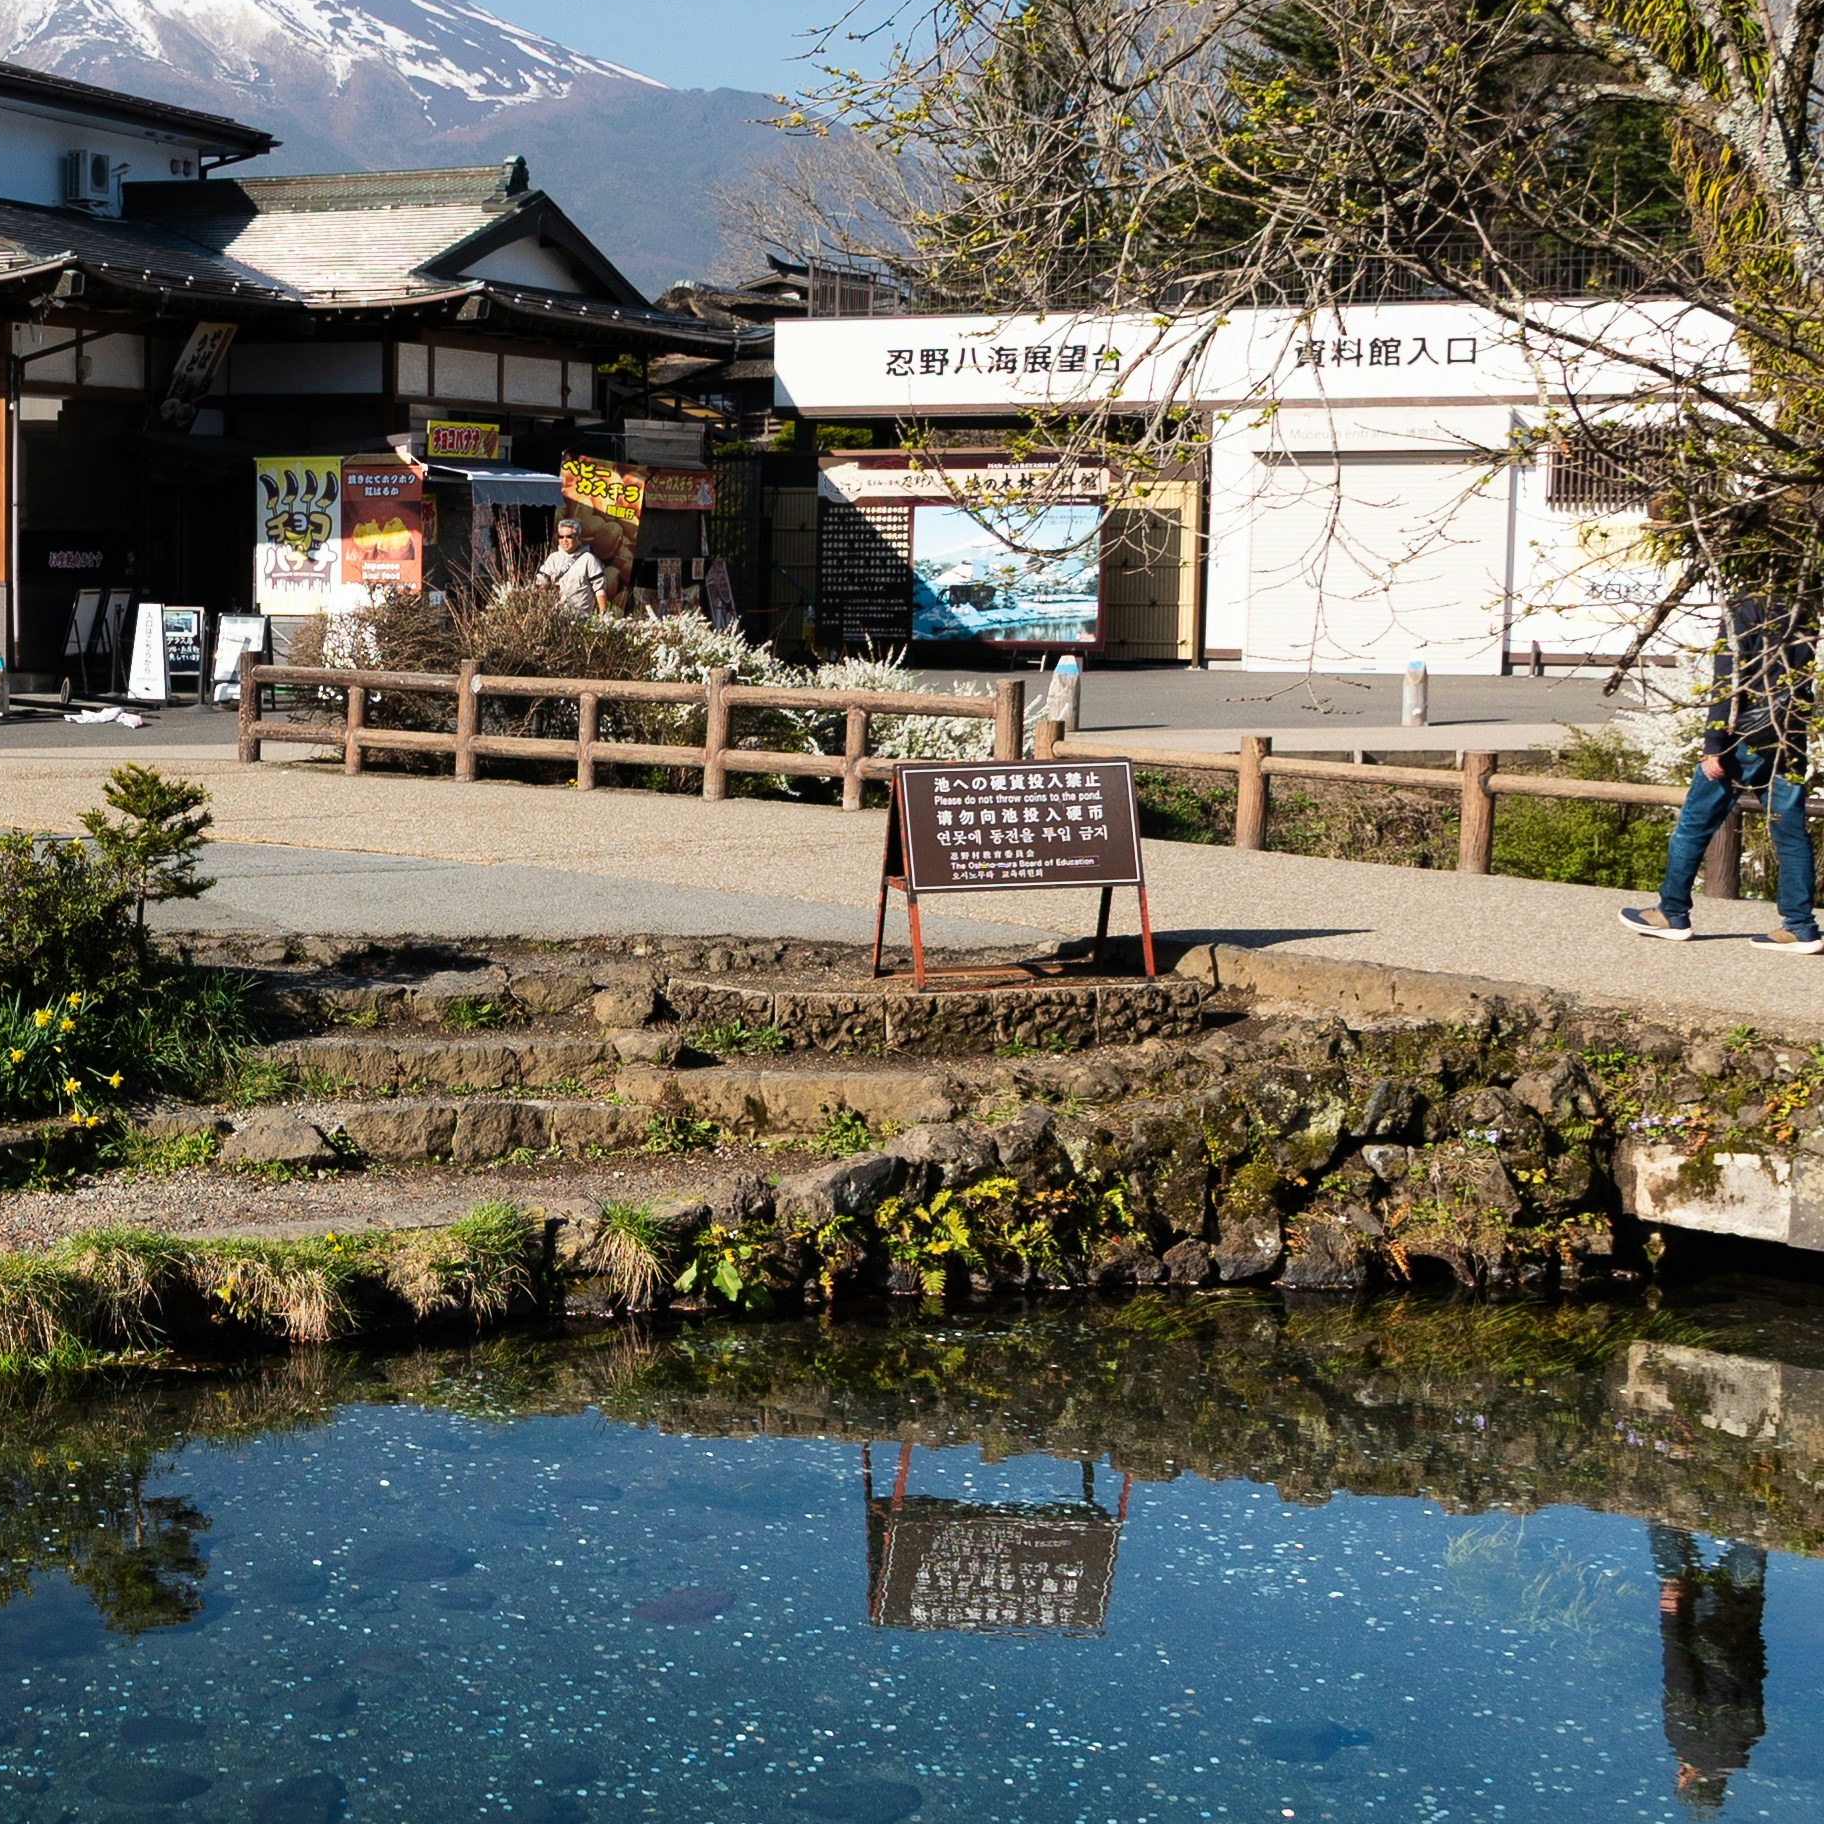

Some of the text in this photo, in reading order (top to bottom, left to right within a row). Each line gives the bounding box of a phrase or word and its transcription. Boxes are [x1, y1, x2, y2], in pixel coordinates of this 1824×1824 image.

[885, 343, 1123, 377] 忍野八海展望台
[1294, 336, 1477, 368] 資料館入口
[432, 425, 482, 455] チョコバナナ
[1289, 428, 1342, 440] Museum
[347, 474, 416, 485] 焼きたてホクホク
[562, 460, 611, 478] ベビー
[364, 486, 399, 497] 紅はるか
[576, 479, 641, 503] カステラ
[265, 511, 333, 547] チョコ
[264, 542, 338, 575] バナナ
[933, 771, 1102, 793] 池への硬貨投入禁止
[934, 790, 1103, 806] Please do not throw coins to the pond.
[936, 804, 1104, 827] 请勿向池投入硬币
[936, 824, 1108, 847] 연못에 동전을 투입 금지
[949, 849, 1036, 861] 忍野村教育委員会
[950, 857, 1095, 871] The Oshino-mura Board of Education
